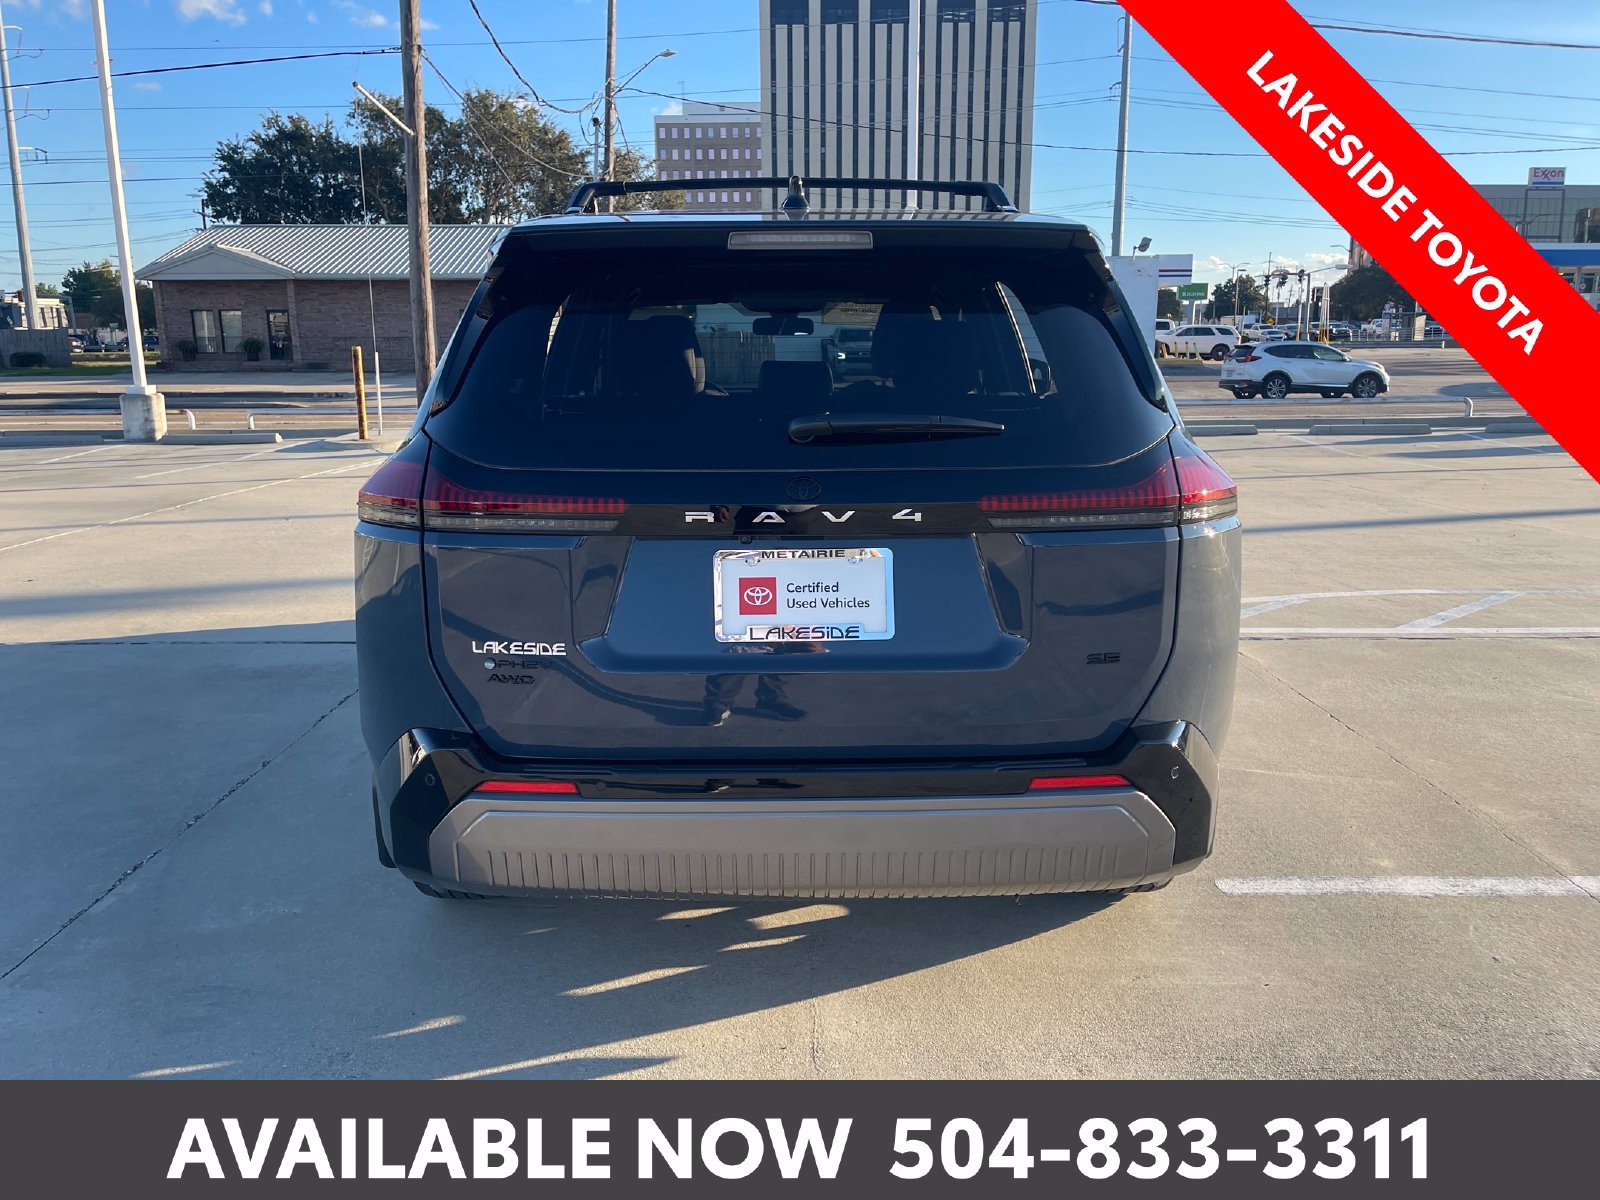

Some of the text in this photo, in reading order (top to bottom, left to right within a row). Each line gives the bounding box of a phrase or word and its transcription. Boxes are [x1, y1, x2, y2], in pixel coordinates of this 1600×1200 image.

[1533, 168, 1564, 180] Exxon
[761, 549, 846, 559] METAIRIE
[786, 582, 839, 593] Certified
[786, 597, 870, 608] Used Vehicles
[472, 640, 567, 656] LAKESIDE
[1086, 652, 1121, 664] SE
[487, 673, 536, 685] AWD
